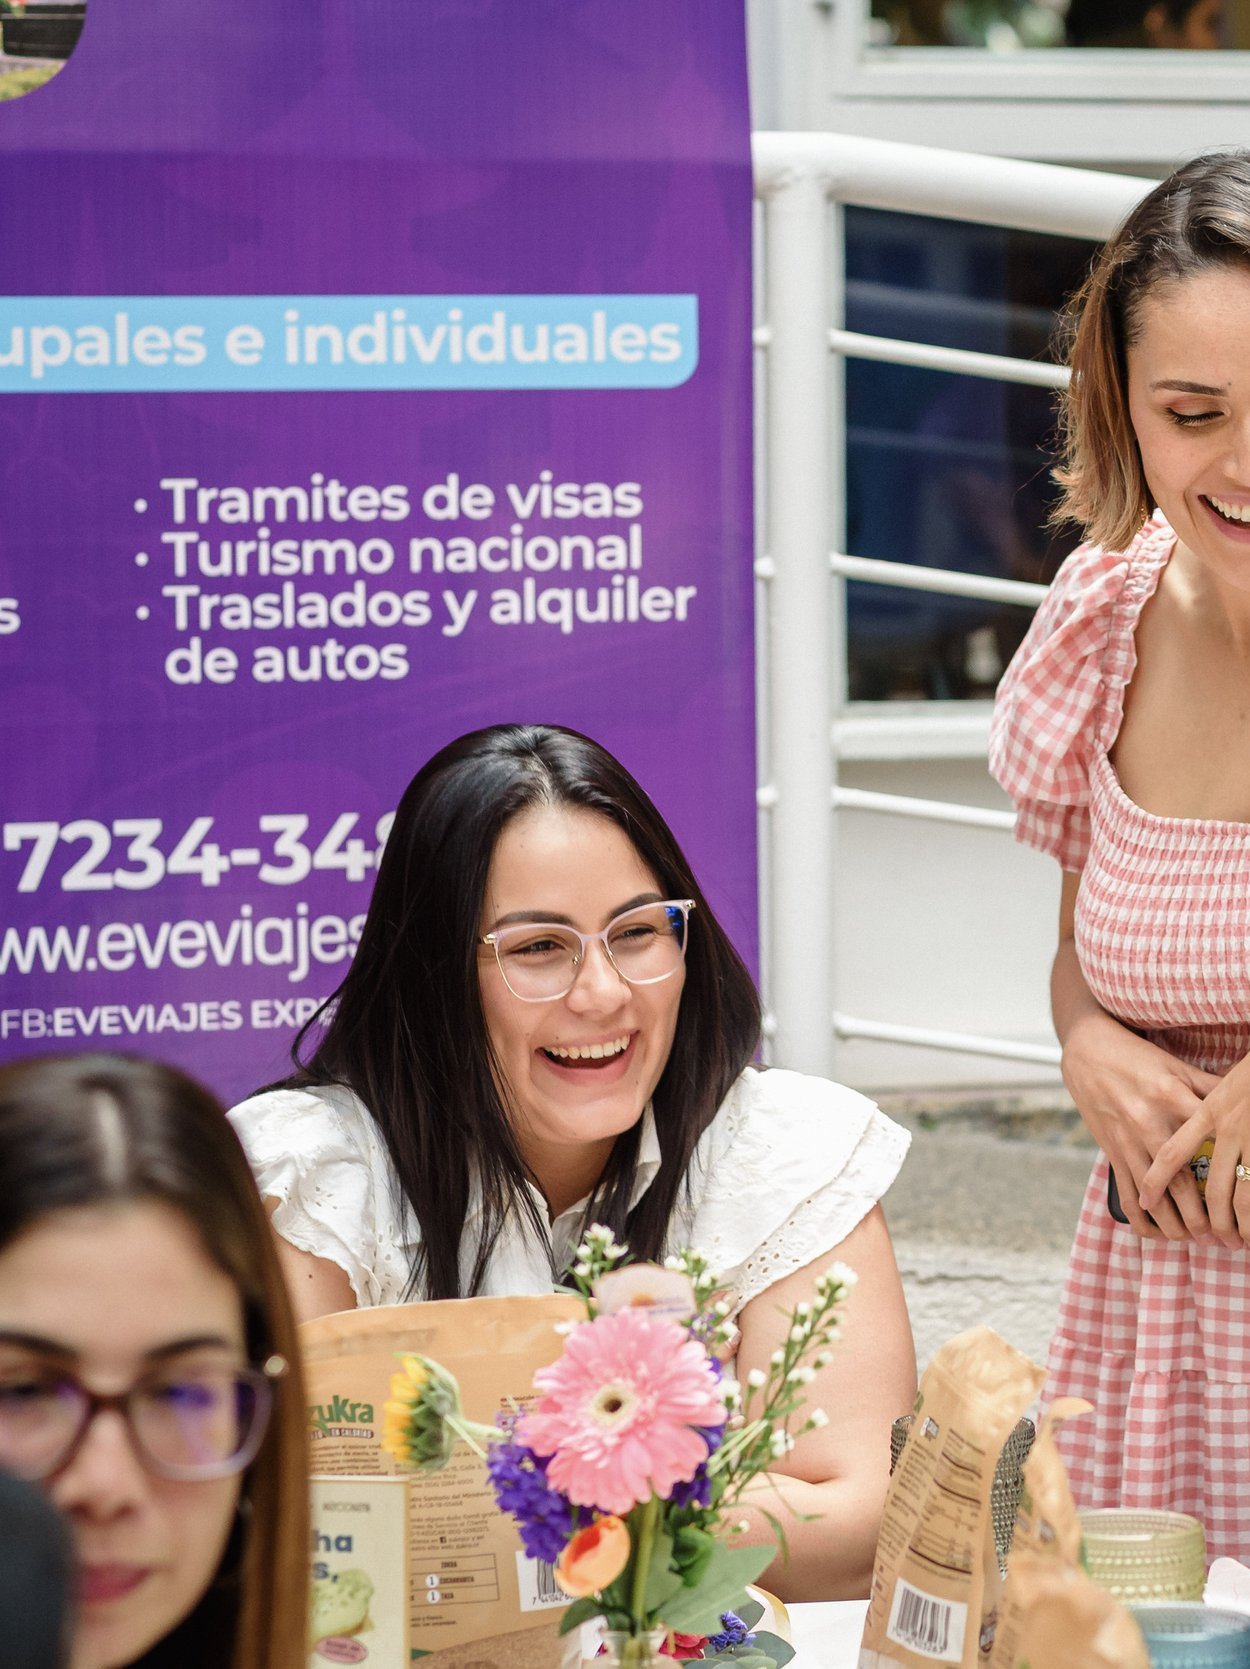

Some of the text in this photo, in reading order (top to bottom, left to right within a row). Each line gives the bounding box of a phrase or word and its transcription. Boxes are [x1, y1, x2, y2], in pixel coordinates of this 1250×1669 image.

[224, 322, 265, 366] e
[283, 308, 683, 367] individuales
[160, 470, 644, 524] Tramites de visas
[162, 524, 643, 577] Turismo nacional
[162, 576, 697, 637] Traslados y alquiler
[164, 637, 410, 684] de autos
[0, 1001, 243, 1039] FB:EVEVIAJES
